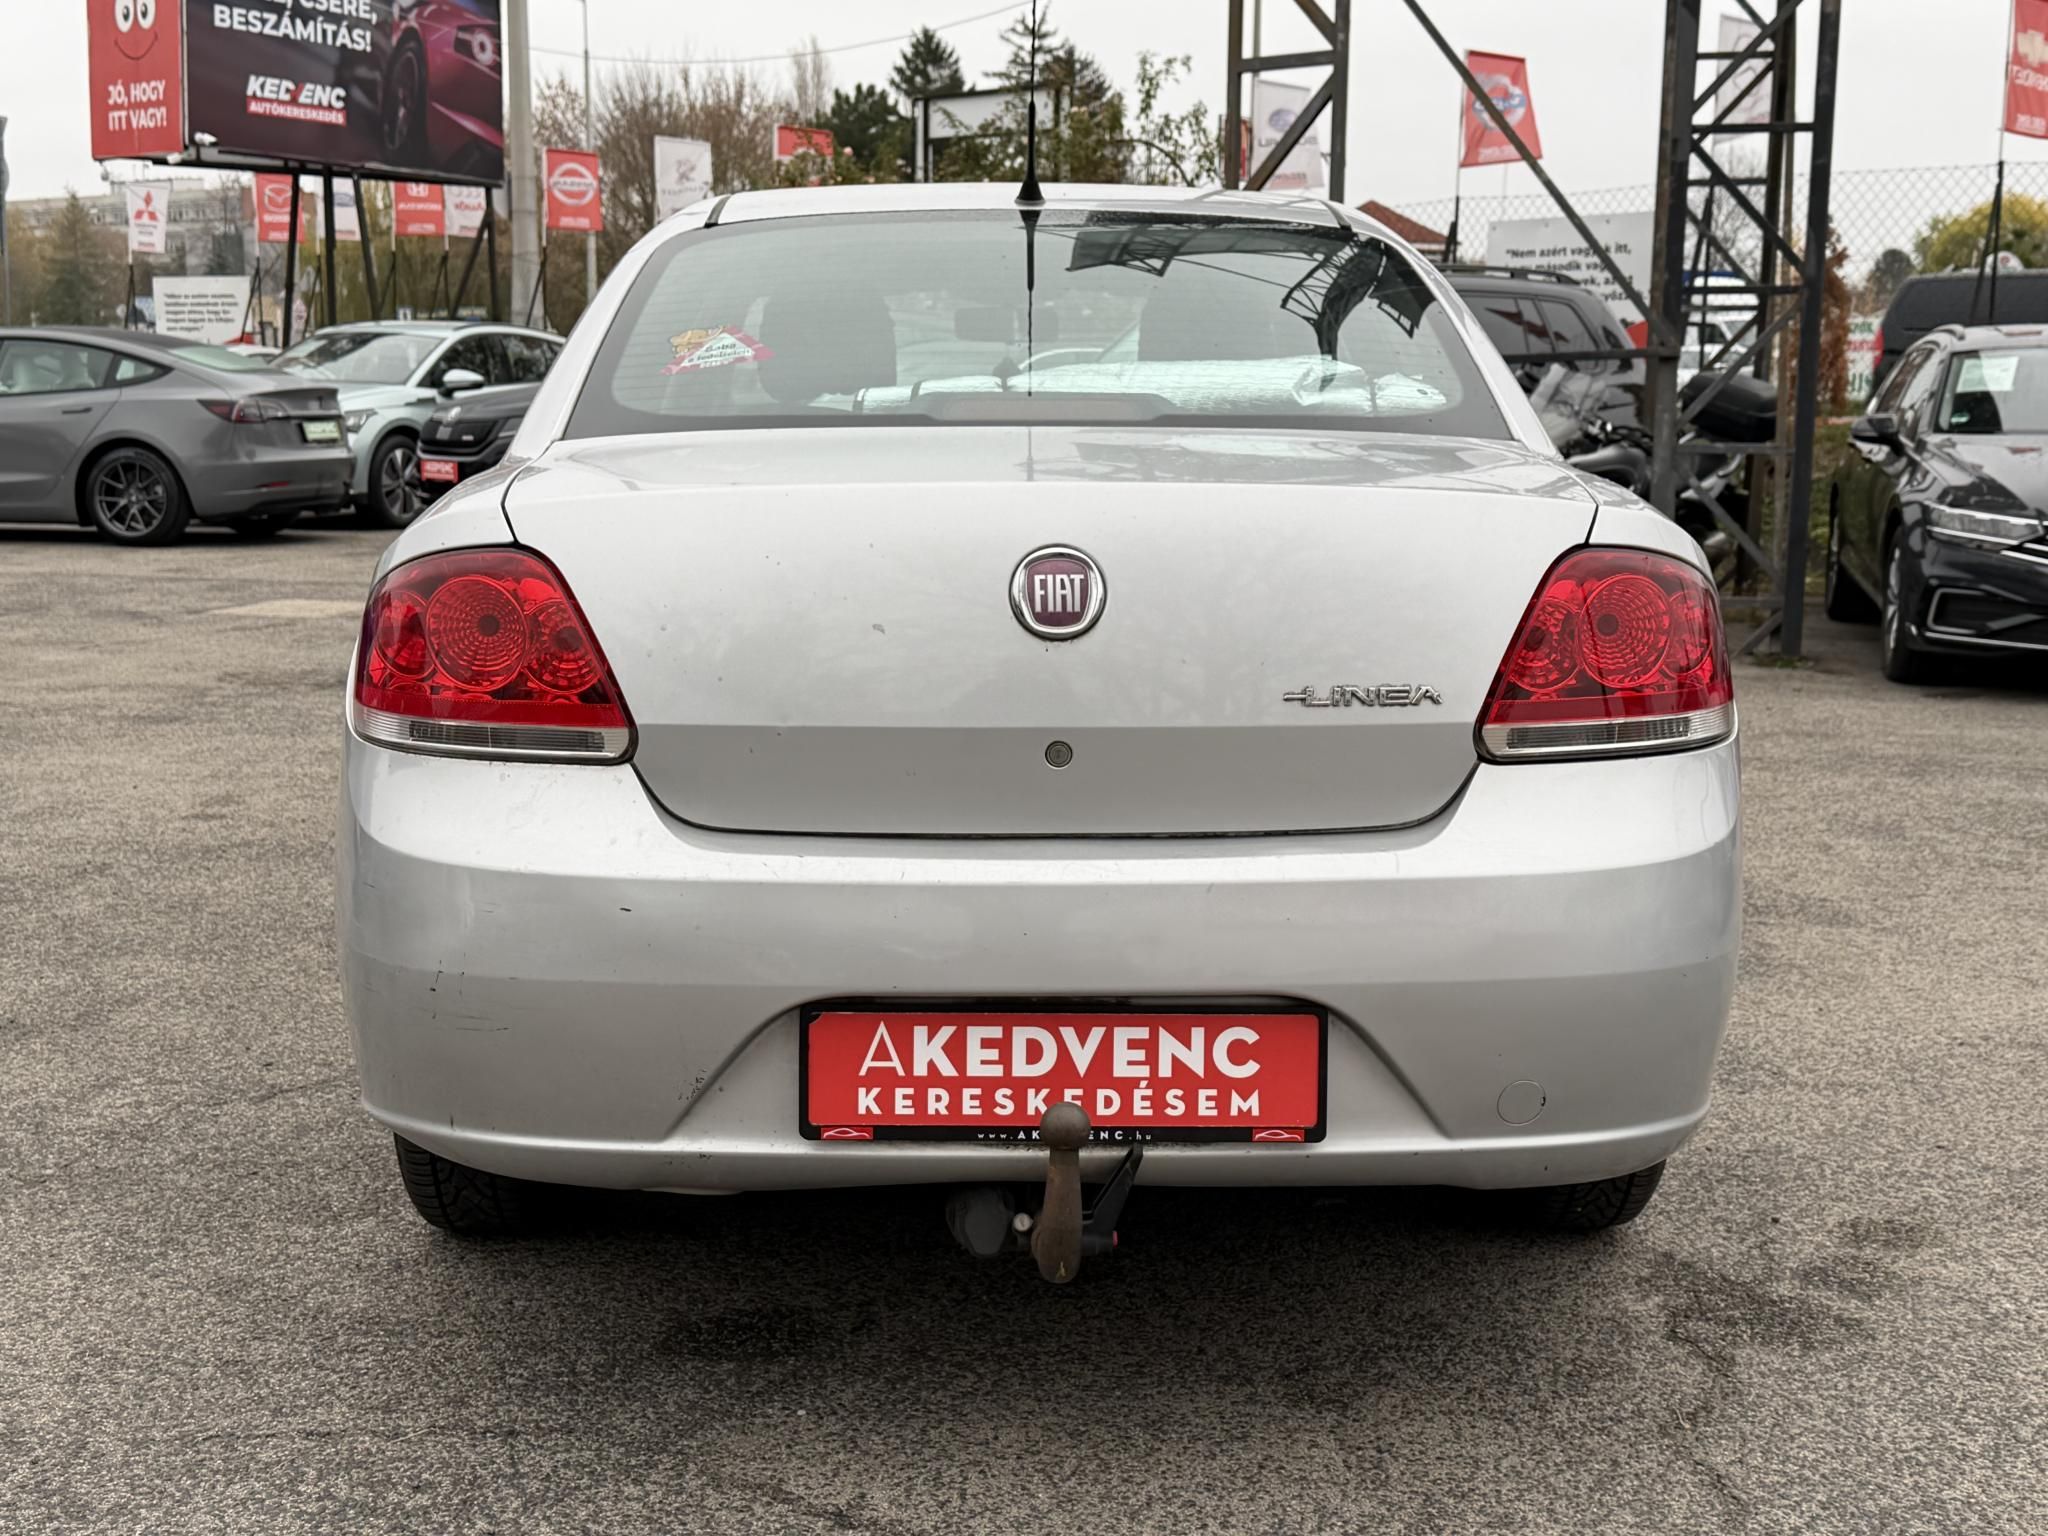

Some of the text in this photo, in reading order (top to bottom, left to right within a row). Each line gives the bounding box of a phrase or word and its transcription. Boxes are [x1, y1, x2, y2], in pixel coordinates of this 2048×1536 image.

[213, 4, 372, 52] BESZÁMÍTÁS!
[107, 79, 166, 107] JÓ, HOGY
[108, 106, 167, 132] ITT VAGY!
[249, 101, 344, 124] AUTÓKERESKEDÉS
[1034, 573, 1084, 613] FIAT
[1284, 685, 1443, 706] LINEA
